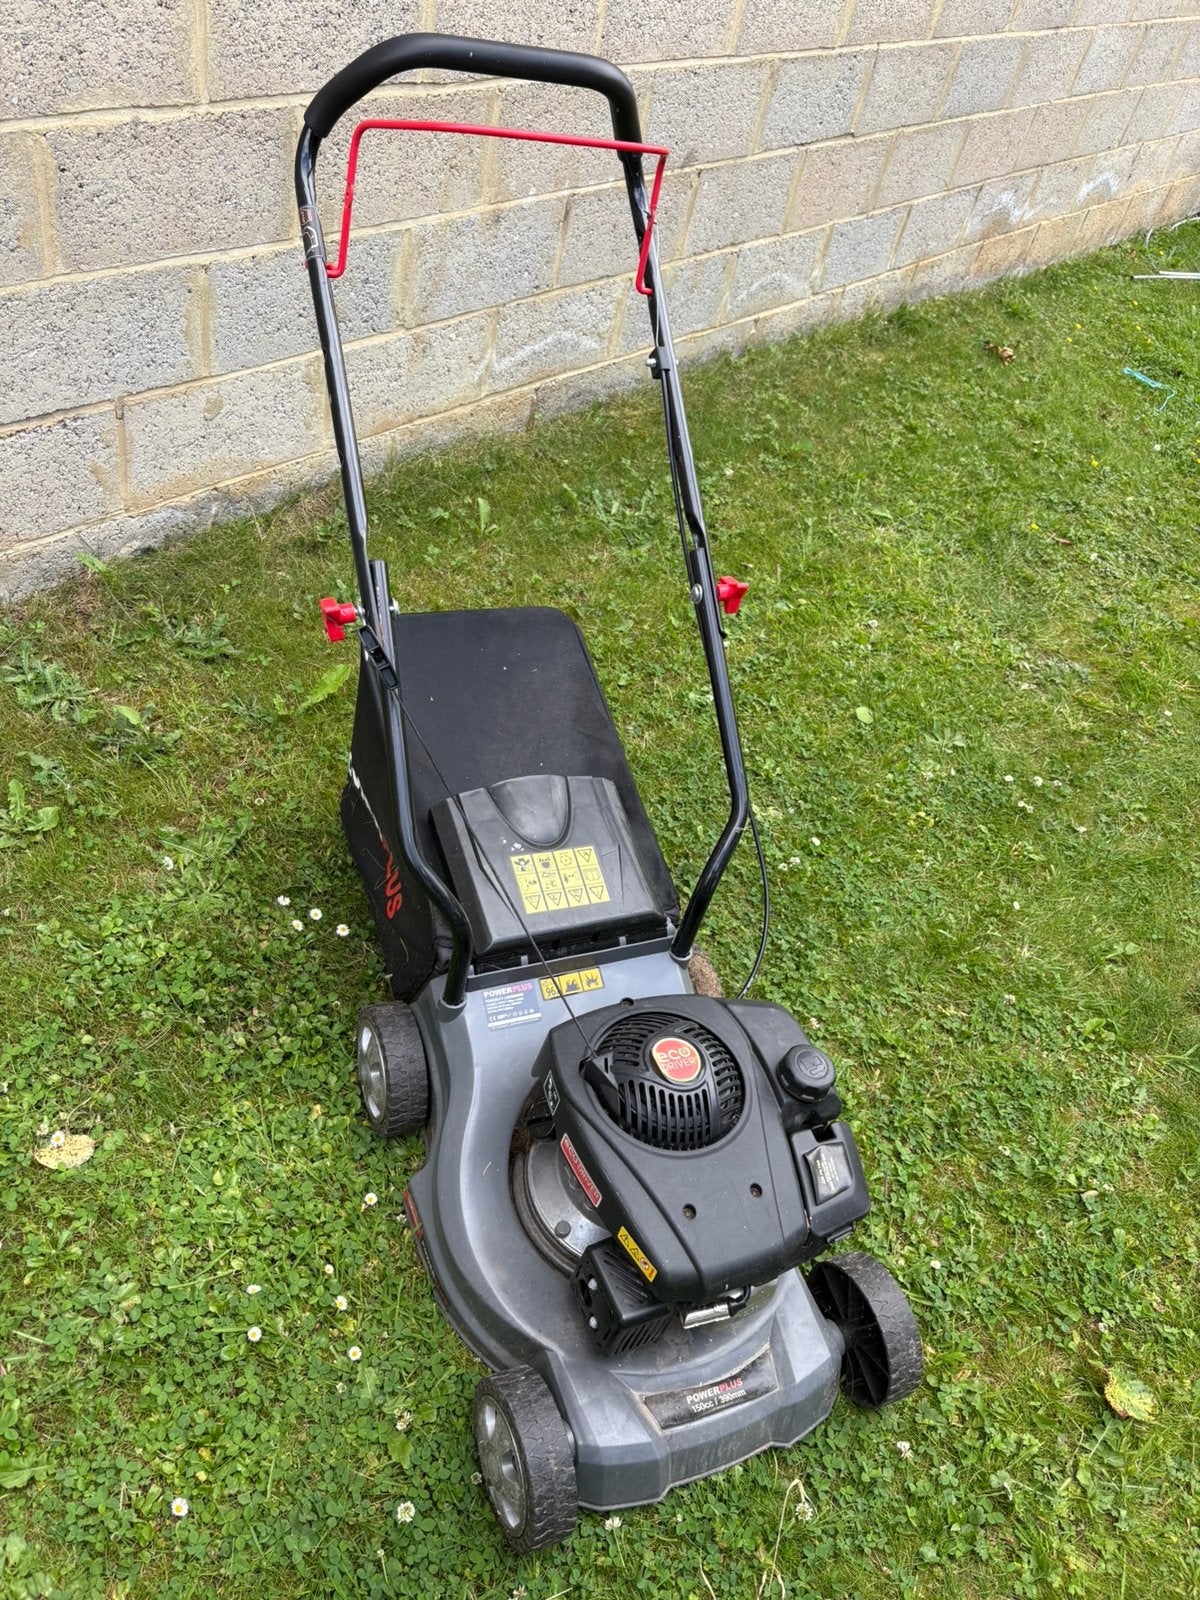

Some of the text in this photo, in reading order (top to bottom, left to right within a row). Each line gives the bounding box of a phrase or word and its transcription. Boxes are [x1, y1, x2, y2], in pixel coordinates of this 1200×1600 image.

[484, 983, 533, 997] POWERPLUS
[661, 1057, 696, 1072] DRIVER
[687, 1378, 743, 1404] POWERPLUS
[691, 1400, 715, 1413] 150cc
[718, 1389, 747, 1404] 390mm
